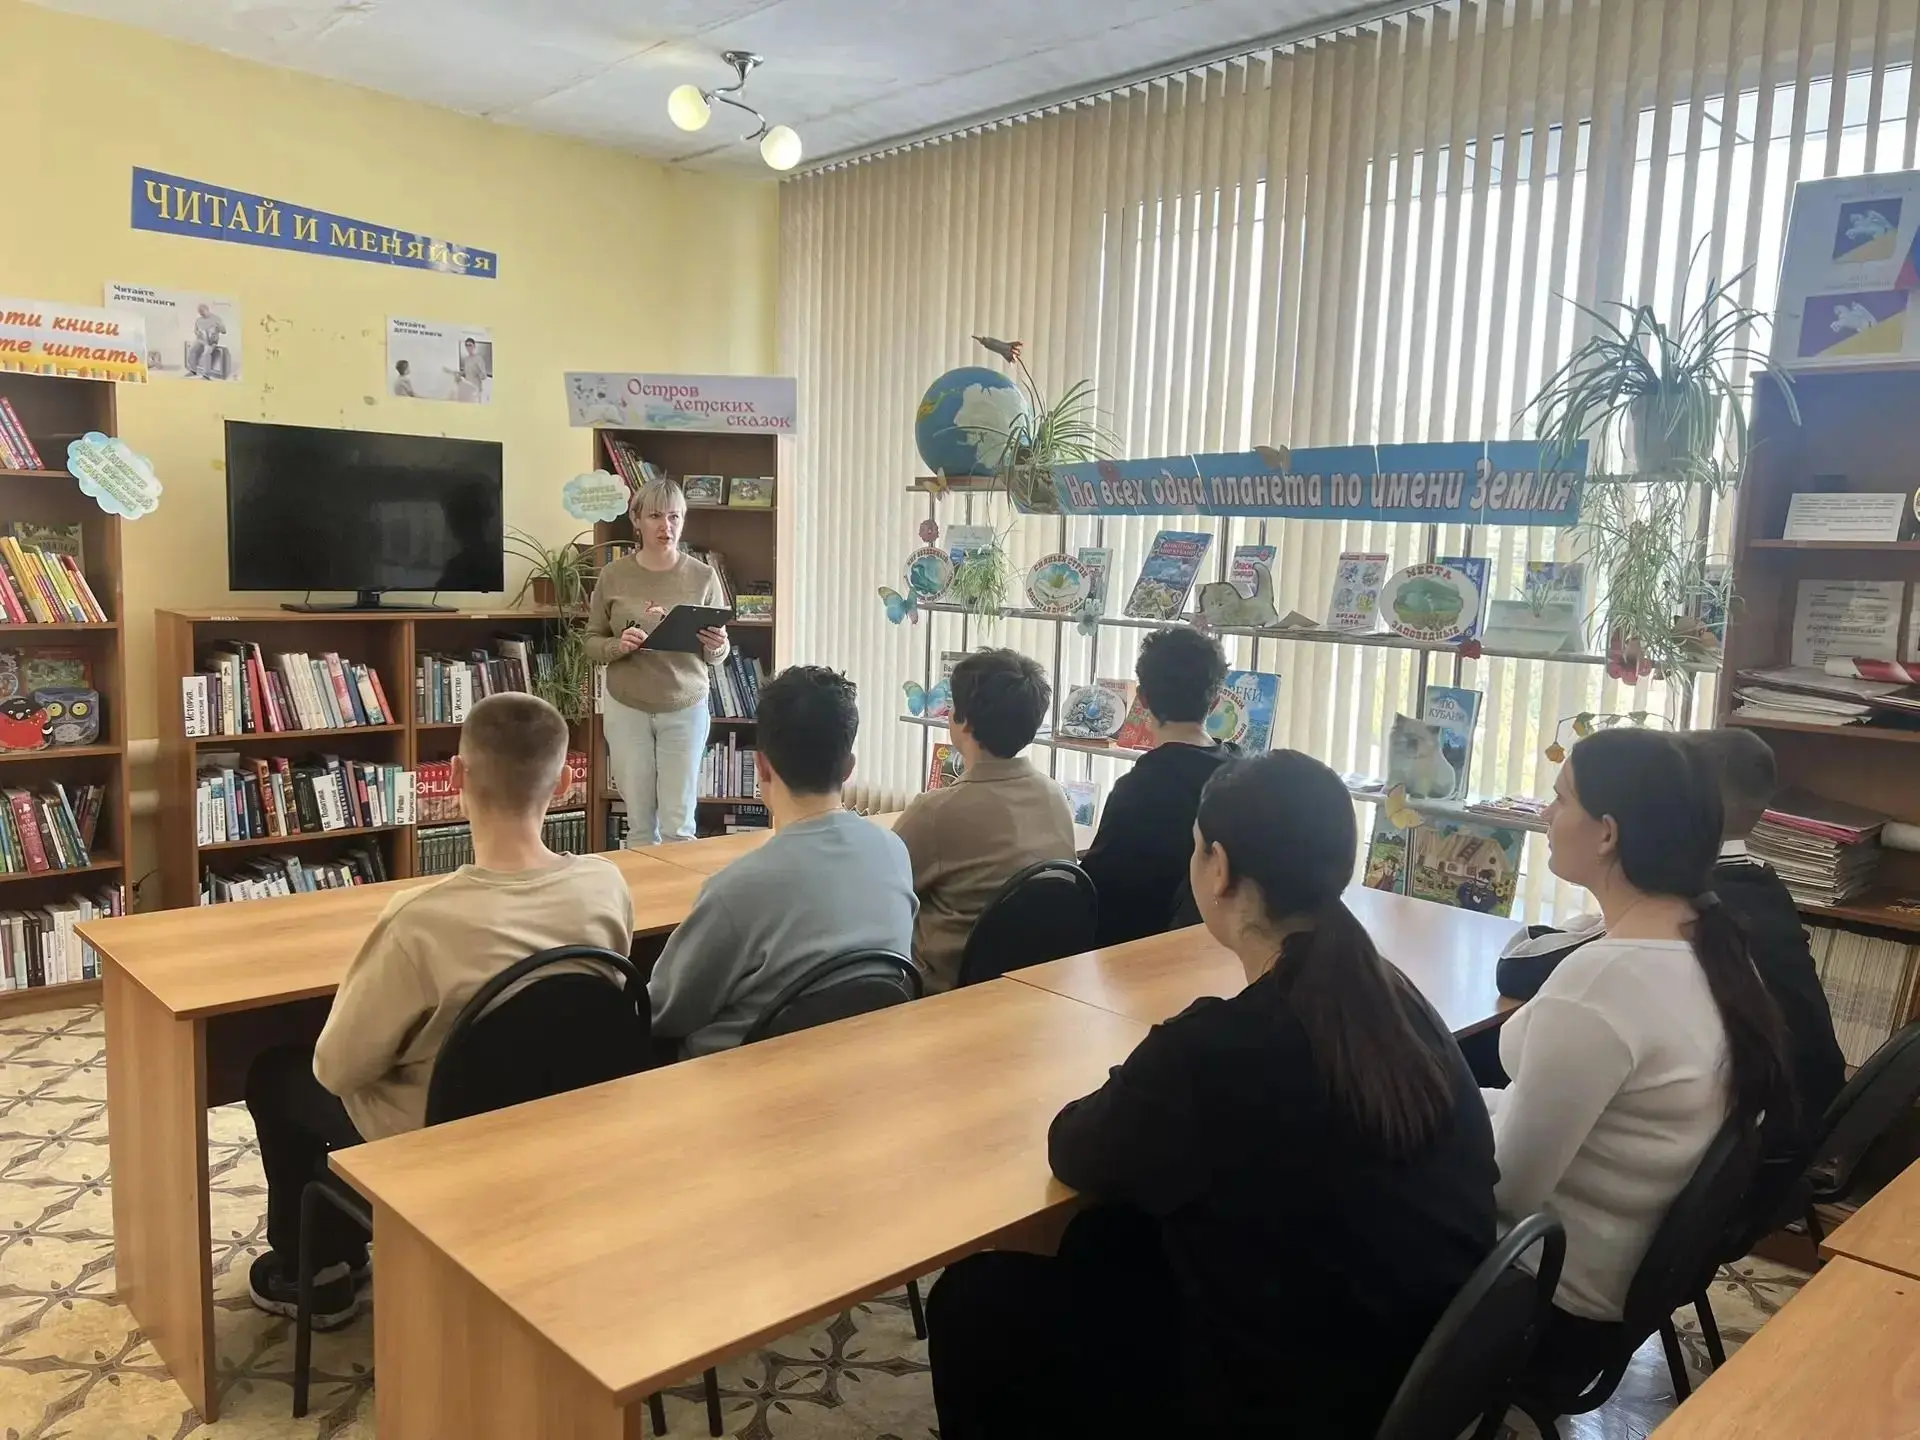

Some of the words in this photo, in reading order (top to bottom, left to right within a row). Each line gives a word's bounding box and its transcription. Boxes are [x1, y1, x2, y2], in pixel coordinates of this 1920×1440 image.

[143, 180, 281, 237] ЧИТАЙ
[292, 214, 319, 243] И
[330, 223, 491, 271] МЕНЯЙСЯ
[113, 285, 155, 297] Читайте
[114, 294, 145, 303] детям
[146, 299, 176, 307] книги
[52, 315, 120, 336] книги
[42, 341, 139, 364] читать
[627, 378, 700, 403] Остров
[673, 398, 755, 417] детских
[726, 415, 792, 428] сказок
[1065, 474, 1099, 508] На
[1101, 475, 1149, 507] всех
[1151, 467, 1205, 507] одна
[1210, 472, 1322, 507] планета
[1330, 471, 1363, 508] по
[1370, 470, 1465, 510] имени
[1469, 456, 1576, 512] Земля
[1406, 565, 1452, 579] МЕСТА
[1391, 620, 1460, 641] ЗАПОВЕДНЫЕ
